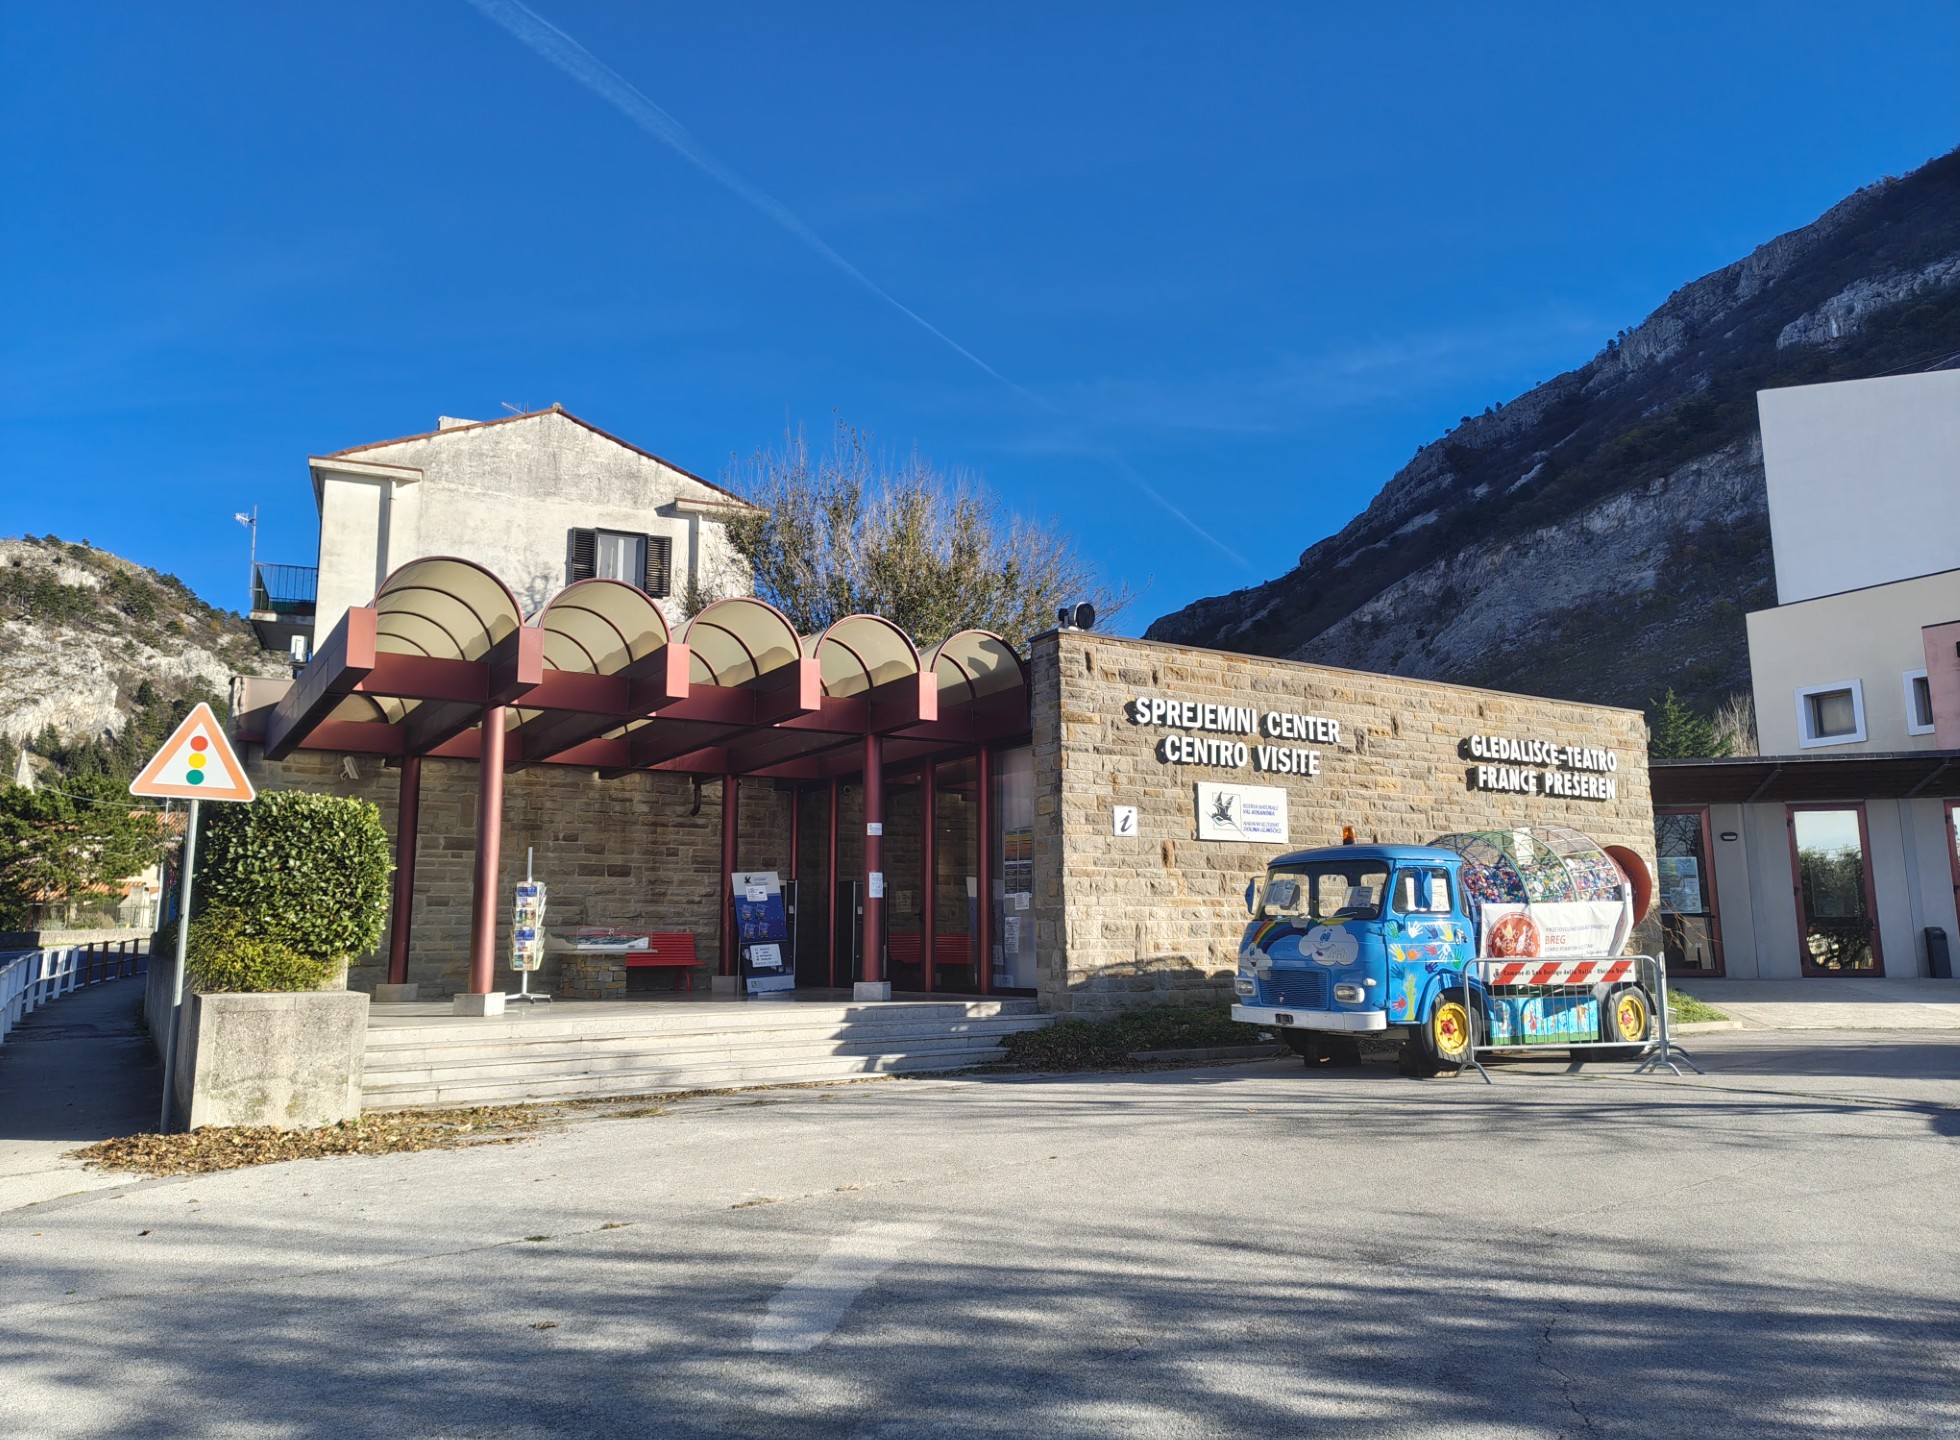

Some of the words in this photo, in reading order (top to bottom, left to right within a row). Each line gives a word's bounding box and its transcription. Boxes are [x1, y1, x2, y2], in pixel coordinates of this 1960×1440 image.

[1135, 697, 1257, 733] SPREJEMNI
[1267, 711, 1341, 743] CENTER
[1165, 734, 1248, 767] CENTRO
[1257, 744, 1321, 774] VISITE
[1471, 734, 1617, 771] GLEDALIŠČE-TEATRO
[1478, 766, 1537, 791] FRANCE
[1545, 771, 1616, 799] PREŠEREN
[1545, 935, 1566, 945] BREG
